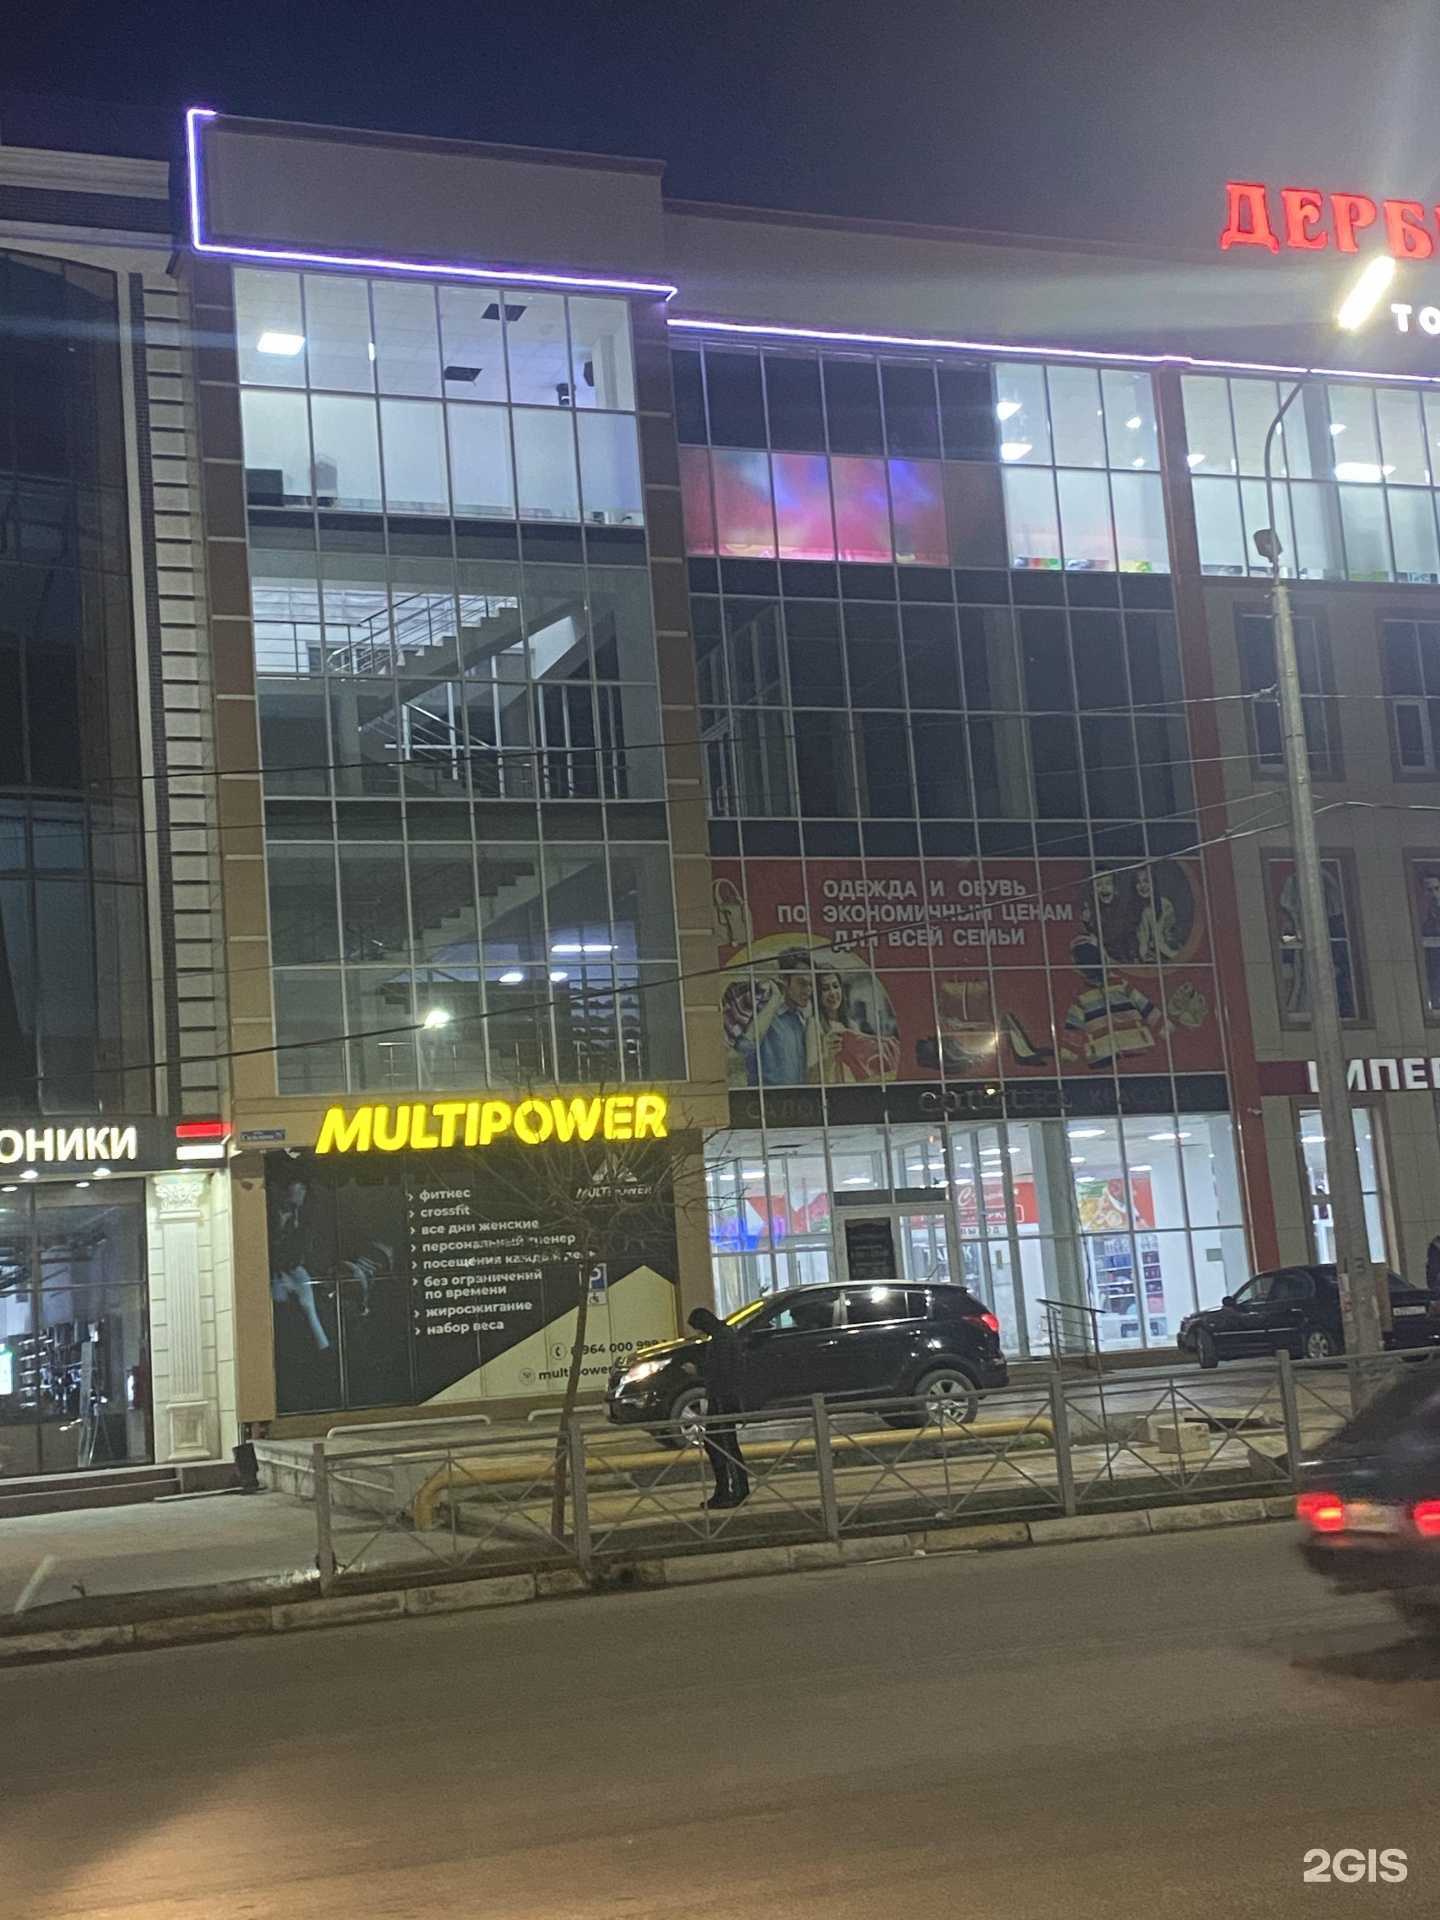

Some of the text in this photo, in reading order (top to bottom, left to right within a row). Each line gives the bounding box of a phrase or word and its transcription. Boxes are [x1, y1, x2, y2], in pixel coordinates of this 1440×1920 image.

[1220, 182, 1440, 260] ДЕРБ
[823, 879, 1027, 900] ОДЕЖДА И ОБУВЬ
[778, 905, 805, 923] ПО
[1002, 902, 1074, 924] ЦЕНАМ
[888, 926, 944, 947] ВСЕЙ
[953, 928, 1025, 947] СЕМЬИ
[1307, 1057, 1440, 1093] МПЕ
[314, 1093, 668, 1154] MULTIPOWER
[0, 1126, 137, 1164] ОНИКИ
[419, 1188, 471, 1202] фитнес
[420, 1204, 470, 1218] crossfit
[421, 1219, 540, 1235] все дни женские
[423, 1256, 501, 1271] посещения
[424, 1269, 543, 1288] без ограничений
[425, 1284, 507, 1300] по времени
[426, 1301, 533, 1318] жиросжигание
[427, 1321, 505, 1336] набор веса
[609, 1341, 633, 1353] 000
[539, 1365, 612, 1381] multower
